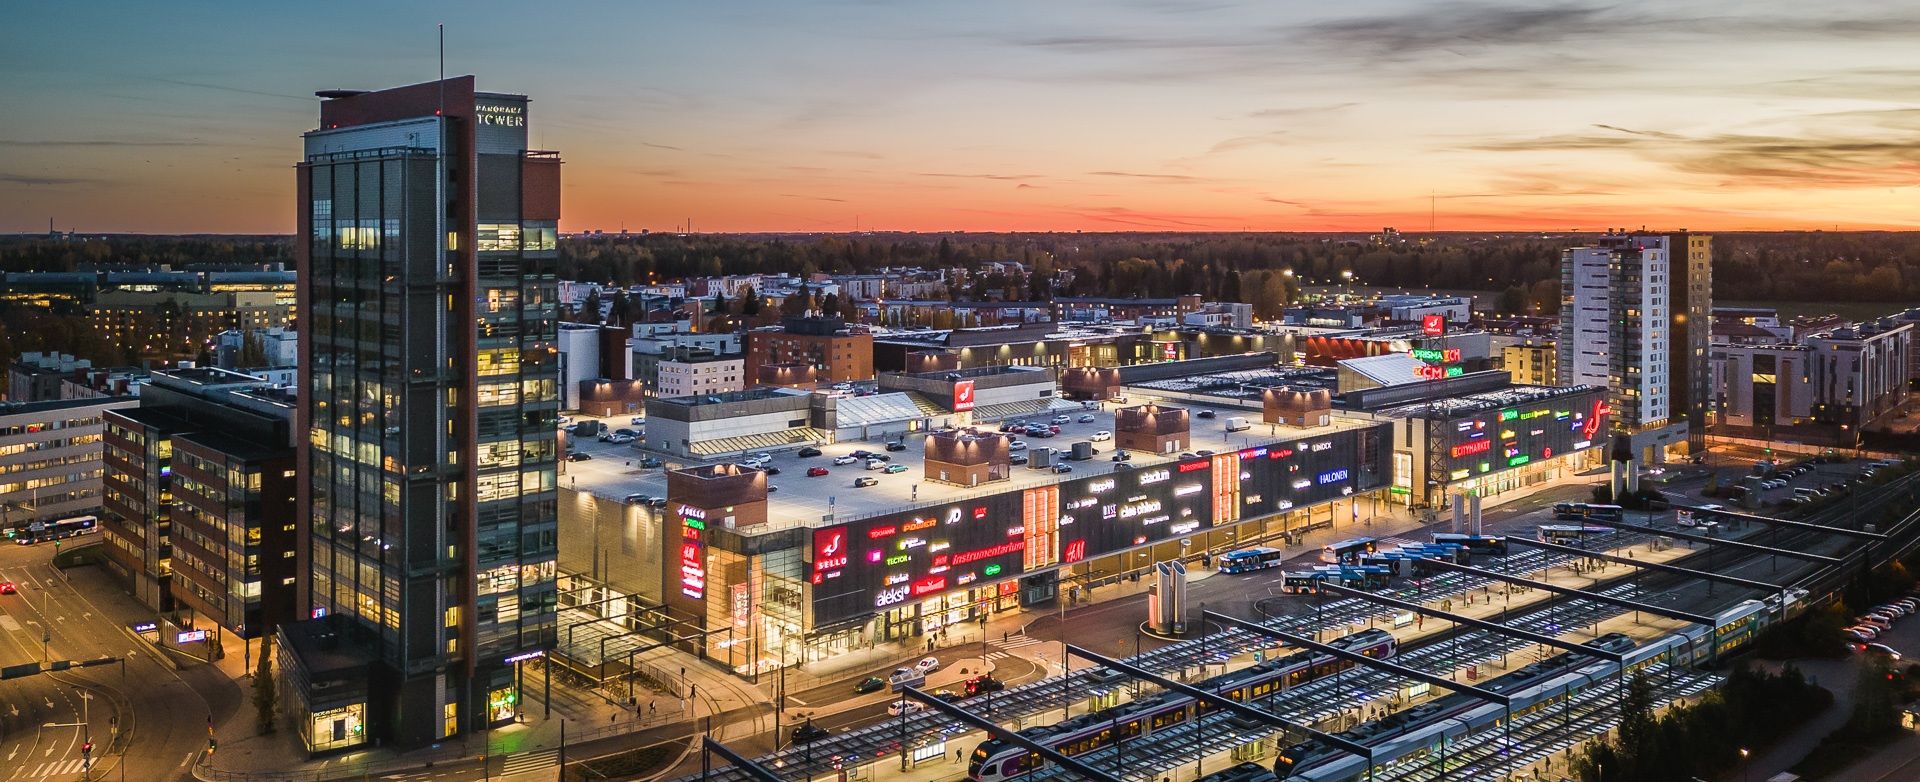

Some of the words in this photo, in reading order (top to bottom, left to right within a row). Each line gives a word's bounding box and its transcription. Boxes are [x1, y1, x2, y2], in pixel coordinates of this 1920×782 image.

[477, 113, 523, 127] TOWER
[1414, 349, 1444, 360] PRISMA
[1140, 469, 1170, 485] stadium
[1320, 469, 1348, 485] HALONEN
[945, 507, 962, 525] JD
[1120, 505, 1137, 519] clas
[1136, 501, 1161, 515] ohlson
[903, 517, 937, 533] POWER
[952, 541, 1025, 566] Instrumentarium
[1066, 541, 1086, 561] H&M
[818, 557, 847, 571] SELLO
[876, 584, 906, 607] aleksi
